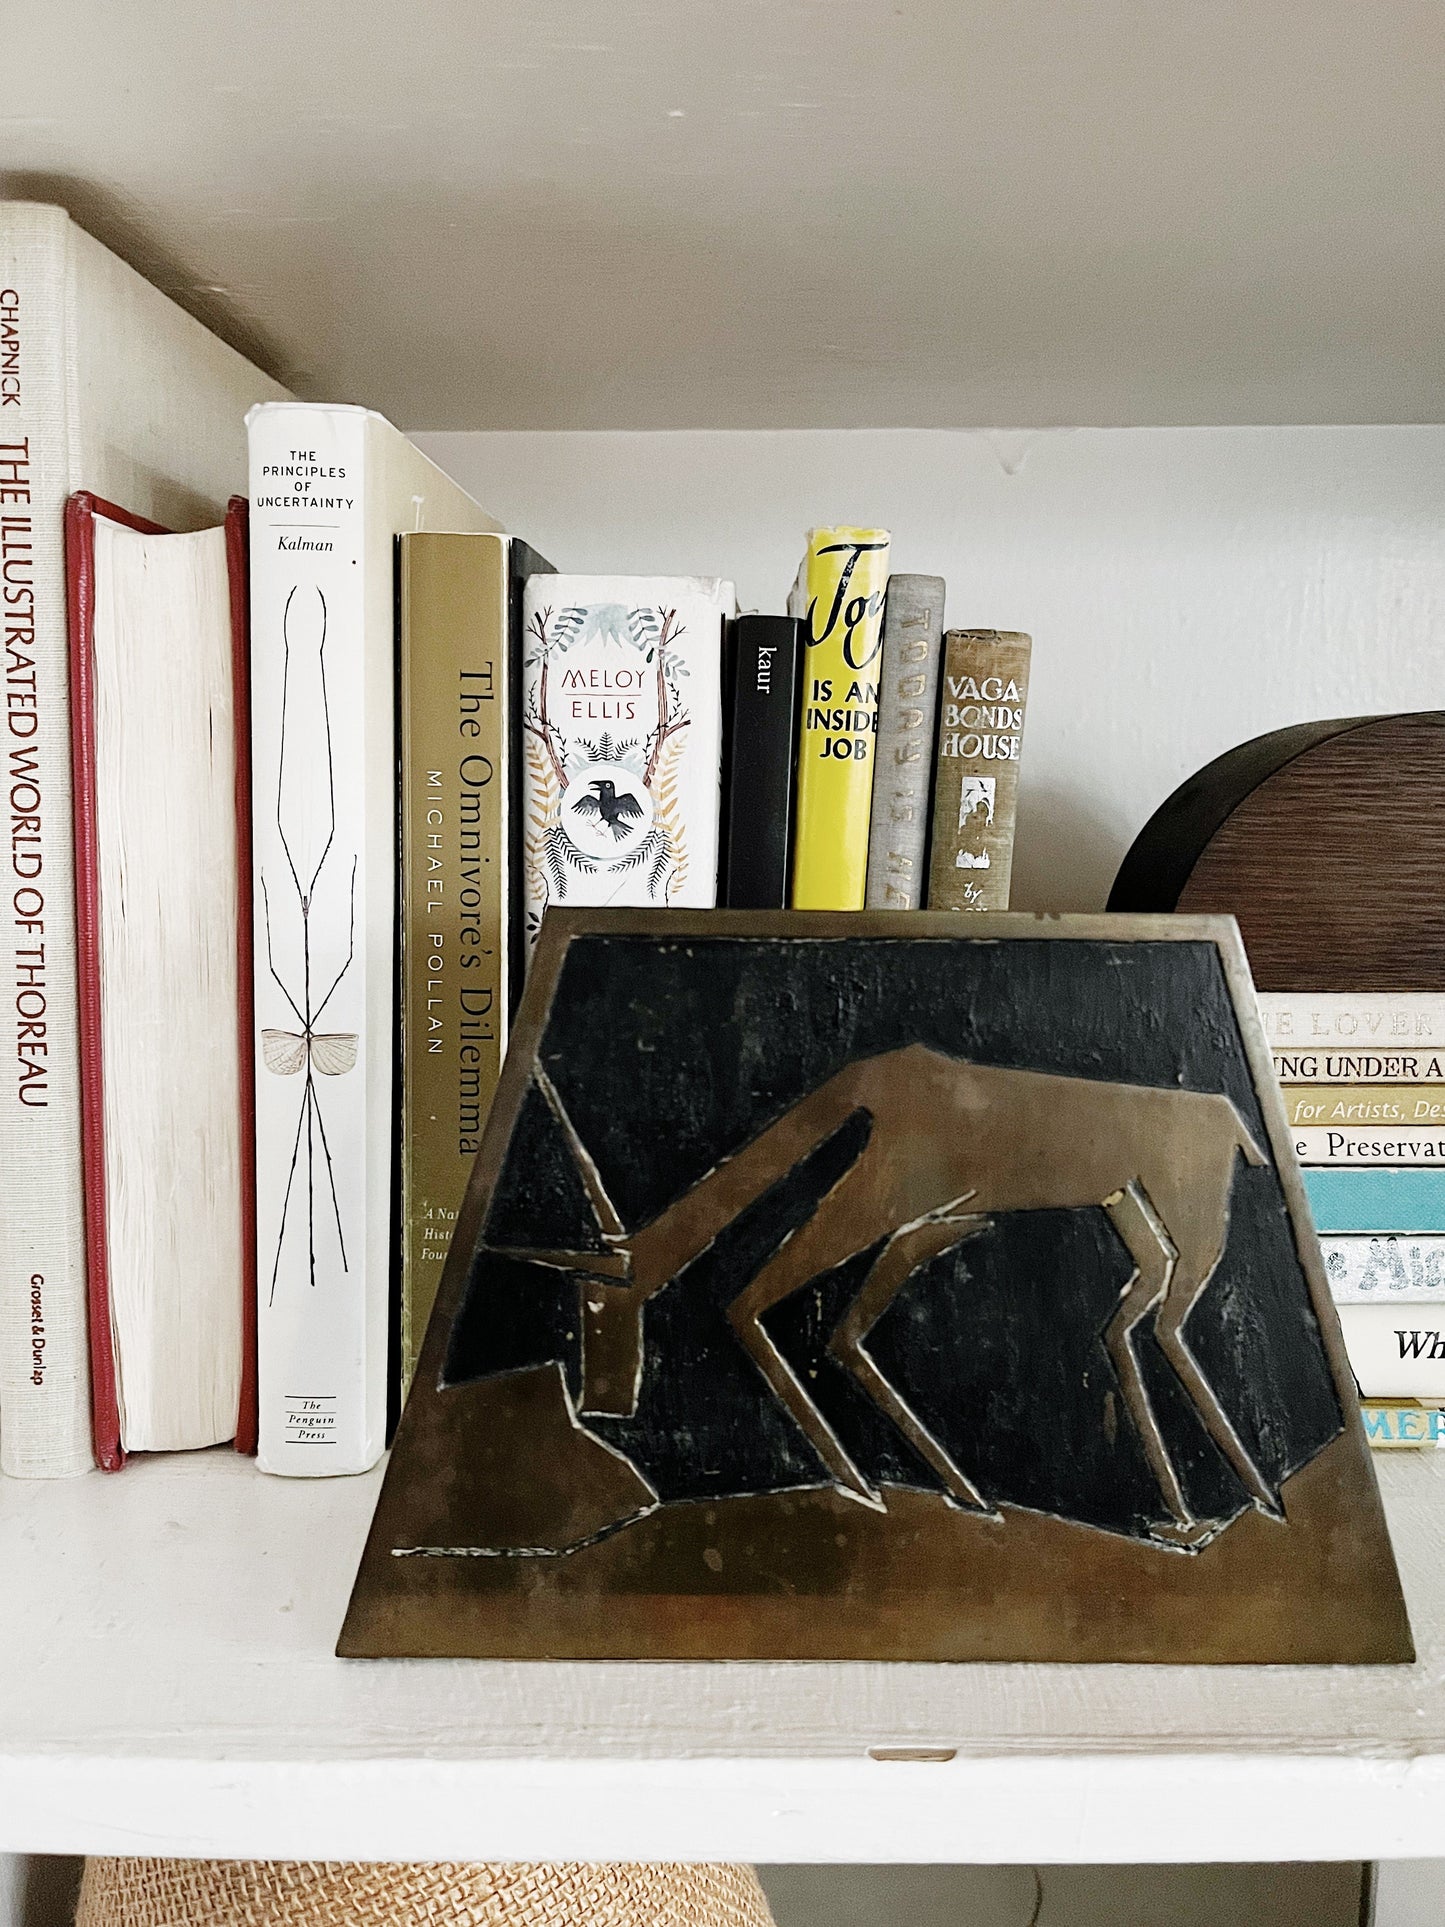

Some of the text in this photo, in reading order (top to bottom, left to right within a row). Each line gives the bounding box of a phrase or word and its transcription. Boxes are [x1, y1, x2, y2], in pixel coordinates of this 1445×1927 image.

[0, 289, 21, 406] CHAPNICK
[290, 450, 316, 461] THE
[263, 466, 346, 478] PRINCIPLES
[294, 481, 312, 492] OF
[257, 497, 354, 509] UNCERTAINTY
[277, 536, 334, 551] Kalman
[806, 542, 890, 670] Joy
[561, 669, 646, 689] MELOY
[756, 646, 777, 694] kaur
[813, 680, 879, 704] IS AN
[894, 608, 931, 765] TODAY
[947, 675, 1023, 703] VAGA-
[572, 701, 635, 720] ELLIS
[944, 703, 1022, 730] BONDS
[819, 737, 867, 760] JOB
[941, 732, 1020, 760] HOUSE
[0, 437, 48, 1106] THE ILLUSTRATED WORLD OF THOREAU
[964, 881, 983, 904] by
[427, 770, 443, 1054] MICHAEL POLLAN
[459, 661, 495, 1156] The Omnivore's Dilemma
[1311, 1012, 1432, 1036] LOVER
[1325, 1056, 1418, 1078] UNDER
[1425, 1057, 1443, 1078] A
[1294, 1100, 1325, 1122] for
[1330, 1101, 1405, 1120] Artists,
[422, 1208, 433, 1220] A
[30, 1273, 47, 1386] Grosset & Dunlap
[1393, 1330, 1445, 1359] Wh
[303, 1401, 321, 1410] The
[289, 1414, 334, 1427] Penguin
[298, 1430, 326, 1439] Press
